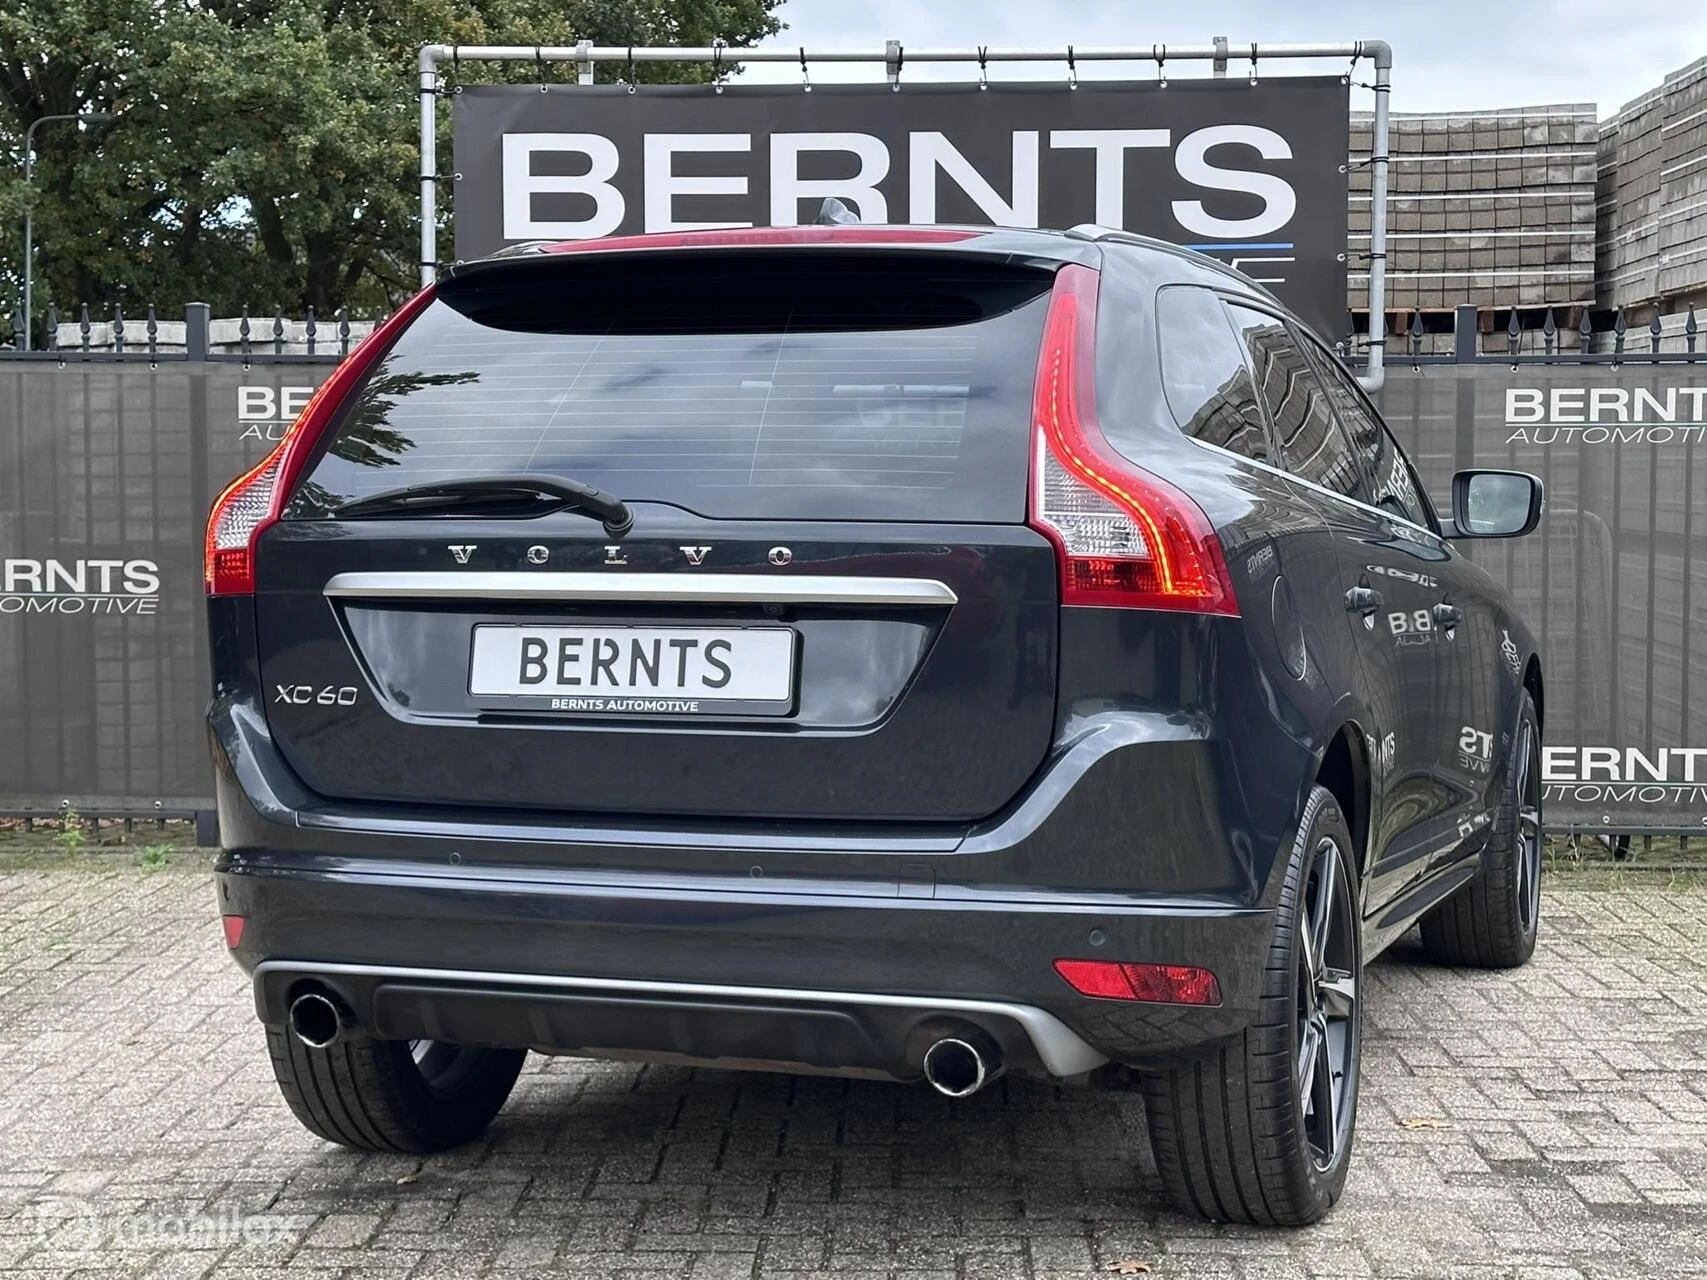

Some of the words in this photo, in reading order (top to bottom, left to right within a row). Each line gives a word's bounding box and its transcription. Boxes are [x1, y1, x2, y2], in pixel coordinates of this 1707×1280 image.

[502, 125, 1297, 241] BERNTS
[1505, 387, 1707, 422] BERNT
[1505, 426, 1706, 444] AUTOMOTI
[448, 545, 793, 566] VOLVO
[0, 559, 160, 594] RNTS
[0, 596, 160, 614] OMOTIVE
[518, 637, 732, 689] BERNTS
[551, 698, 604, 710] BERNTS
[606, 700, 699, 712] AUTOMOTIVE
[1541, 746, 1707, 782] ERNT
